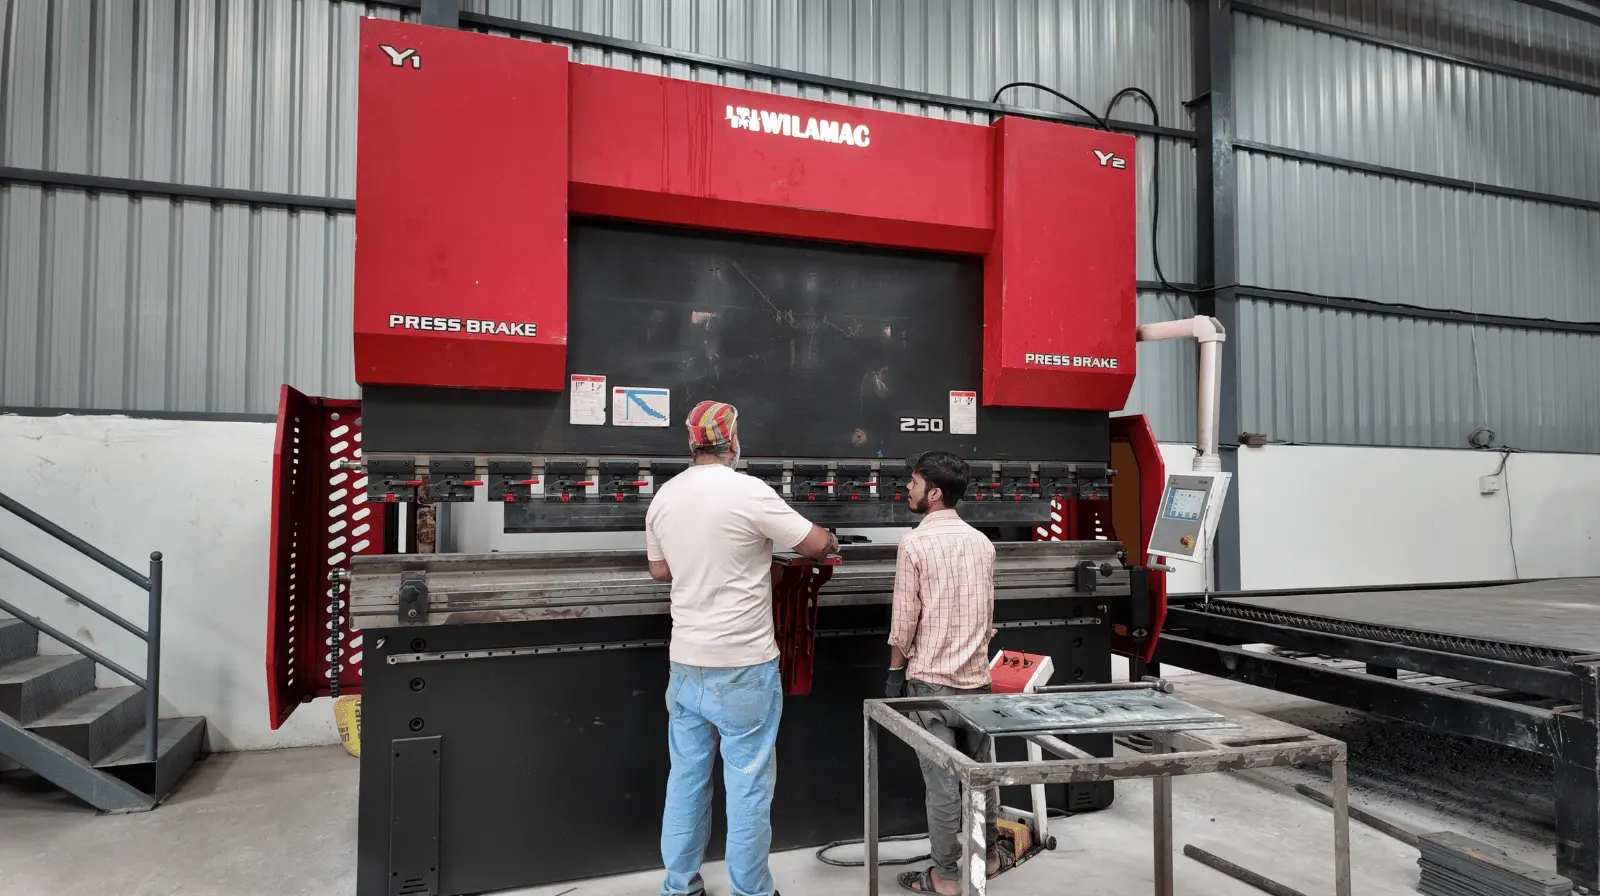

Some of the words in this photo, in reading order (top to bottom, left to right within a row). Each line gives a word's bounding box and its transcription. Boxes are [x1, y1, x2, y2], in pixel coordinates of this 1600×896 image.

[379, 44, 421, 69] Y1
[760, 110, 871, 147] WILAMAC
[1092, 149, 1126, 169] Y2
[389, 314, 462, 332] PRESS
[465, 319, 537, 337] BRAKE
[1025, 353, 1070, 366] PRESS
[1073, 356, 1118, 369] BRAKE
[900, 417, 944, 432] 250
